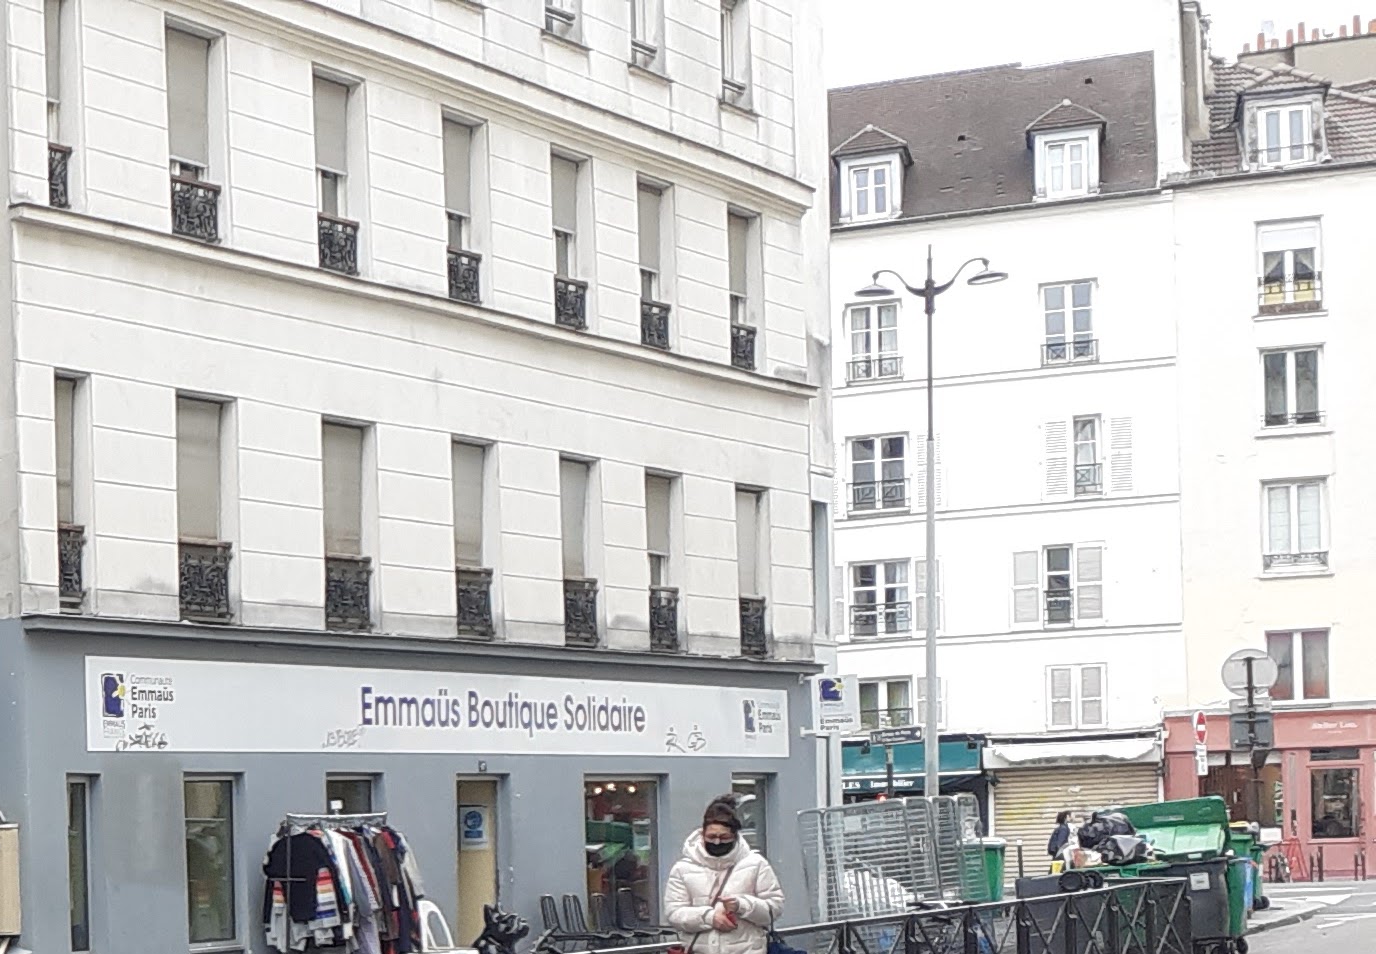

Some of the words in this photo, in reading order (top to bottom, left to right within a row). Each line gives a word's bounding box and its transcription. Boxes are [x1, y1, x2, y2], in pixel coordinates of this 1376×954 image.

[131, 686, 174, 702] Emmaüs
[131, 703, 157, 719] Paris
[360, 686, 461, 728] Emmaüs
[467, 690, 558, 738] Boutique
[563, 694, 647, 733] Solidaire
